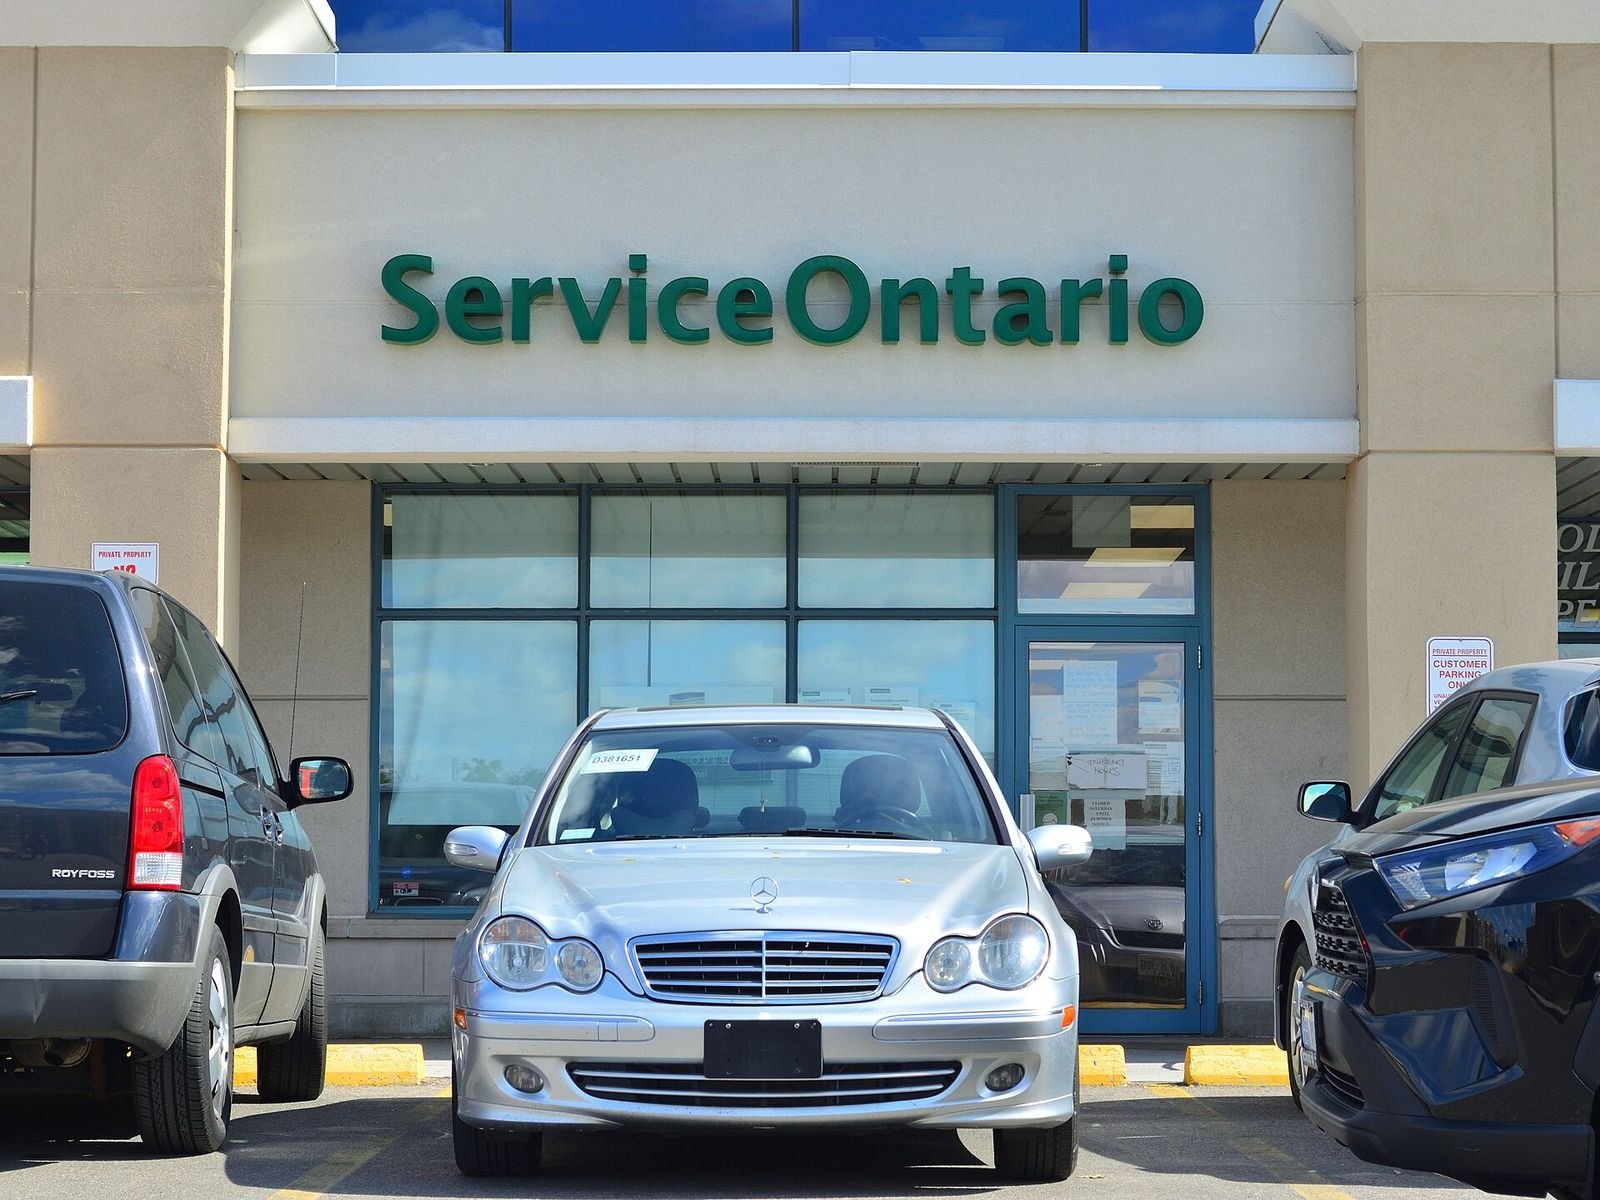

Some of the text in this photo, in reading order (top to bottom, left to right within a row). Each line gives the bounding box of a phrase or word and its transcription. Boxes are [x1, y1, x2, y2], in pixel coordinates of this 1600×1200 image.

[380, 254, 1205, 346] ServiceOntario
[1433, 660, 1488, 668] CUSTOMER
[1439, 670, 1482, 678] PARKING
[1448, 681, 1468, 689] ON
[592, 755, 641, 764] D381651
[51, 868, 116, 879] ROYFOSS
